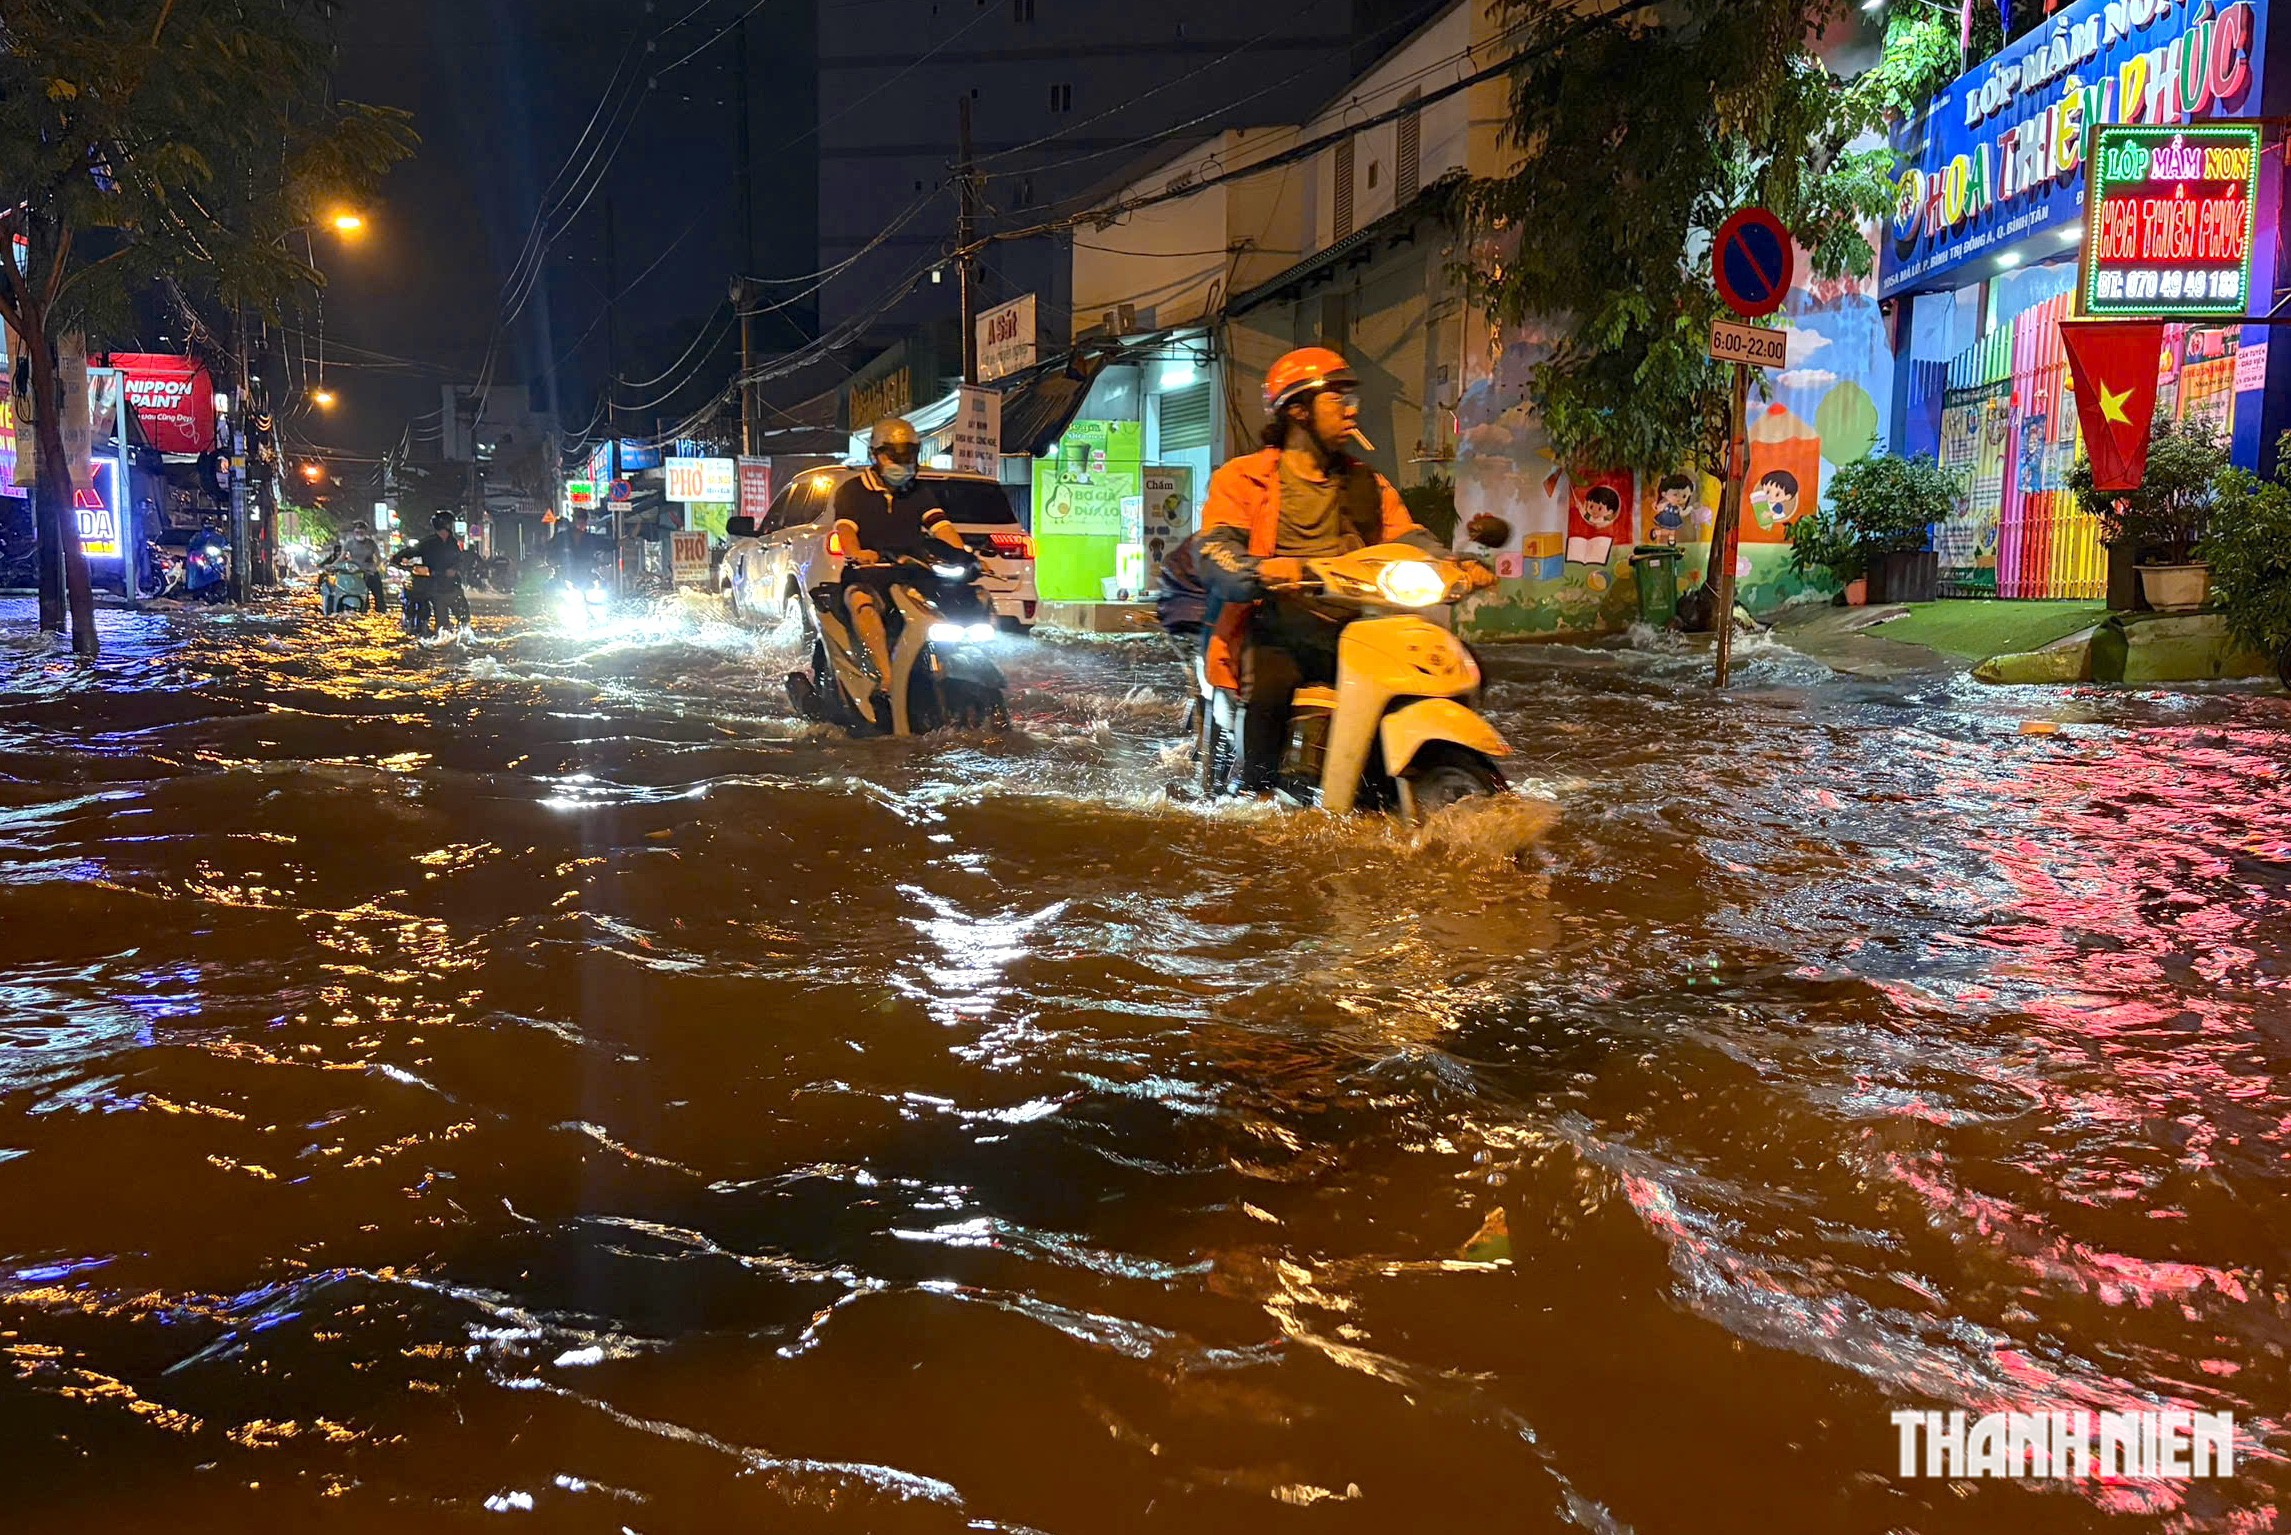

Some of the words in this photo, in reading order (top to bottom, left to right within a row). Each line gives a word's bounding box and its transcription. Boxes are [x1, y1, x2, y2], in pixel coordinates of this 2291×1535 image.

[1964, 60, 2021, 126] LỚP
[2102, 0, 2184, 44] NO
[1924, 142, 1991, 237] HOA
[2119, 1, 2254, 124] PHÚC
[2106, 139, 2149, 180] LỚP
[2203, 147, 2250, 180] NON
[2006, 216, 2029, 235] BÌNH
[2029, 204, 2049, 225] TÂN
[2100, 199, 2137, 259] HOA
[1713, 330, 1783, 360] 6:00-22:00
[125, 379, 193, 395] NIPPON
[130, 394, 181, 408] PAINT
[668, 461, 704, 496] PHỞ
[674, 533, 705, 561] PHỞ
[1527, 541, 1538, 555] 1
[1501, 560, 1512, 575] 2
